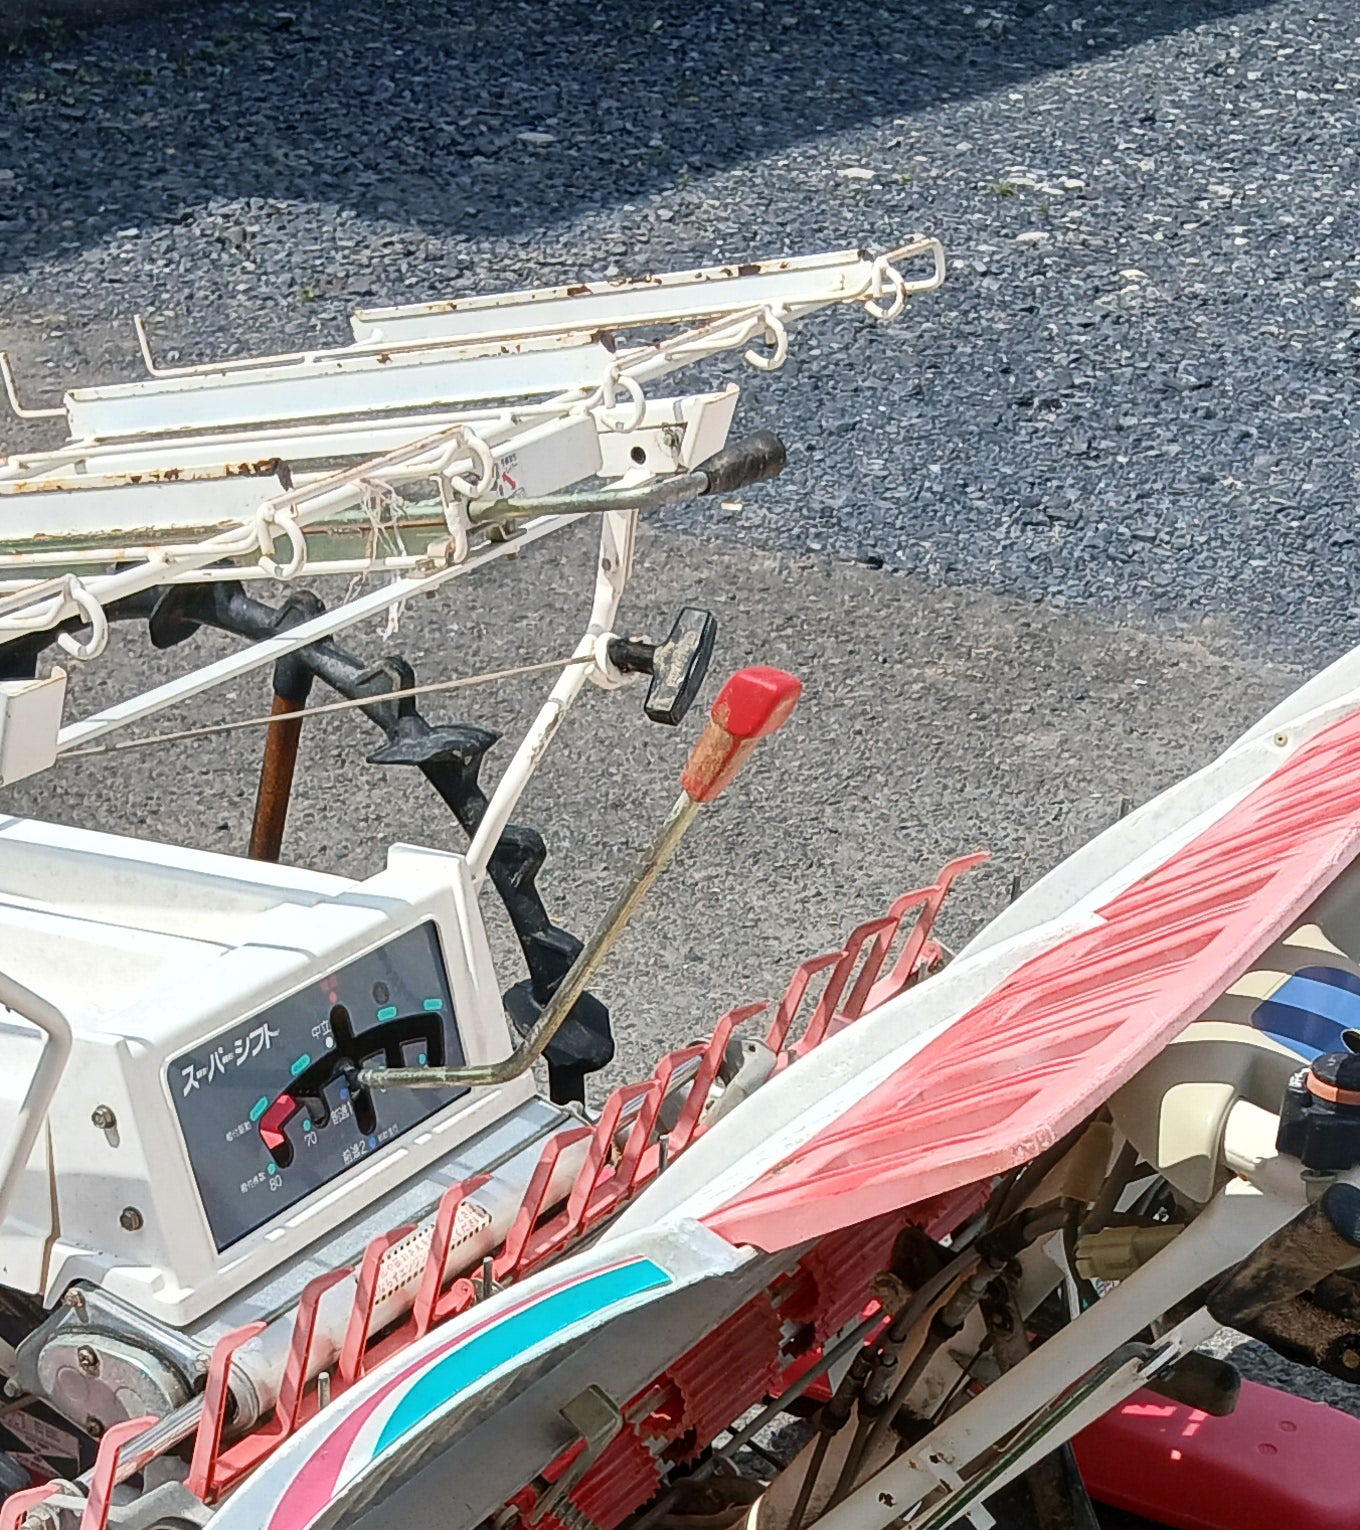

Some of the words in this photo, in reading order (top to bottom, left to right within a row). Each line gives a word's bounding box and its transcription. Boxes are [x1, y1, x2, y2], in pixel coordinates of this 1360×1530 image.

[181, 1023, 280, 1097] スーパーシフト
[304, 1131, 317, 1146] 70
[269, 1174, 283, 1191] 80
